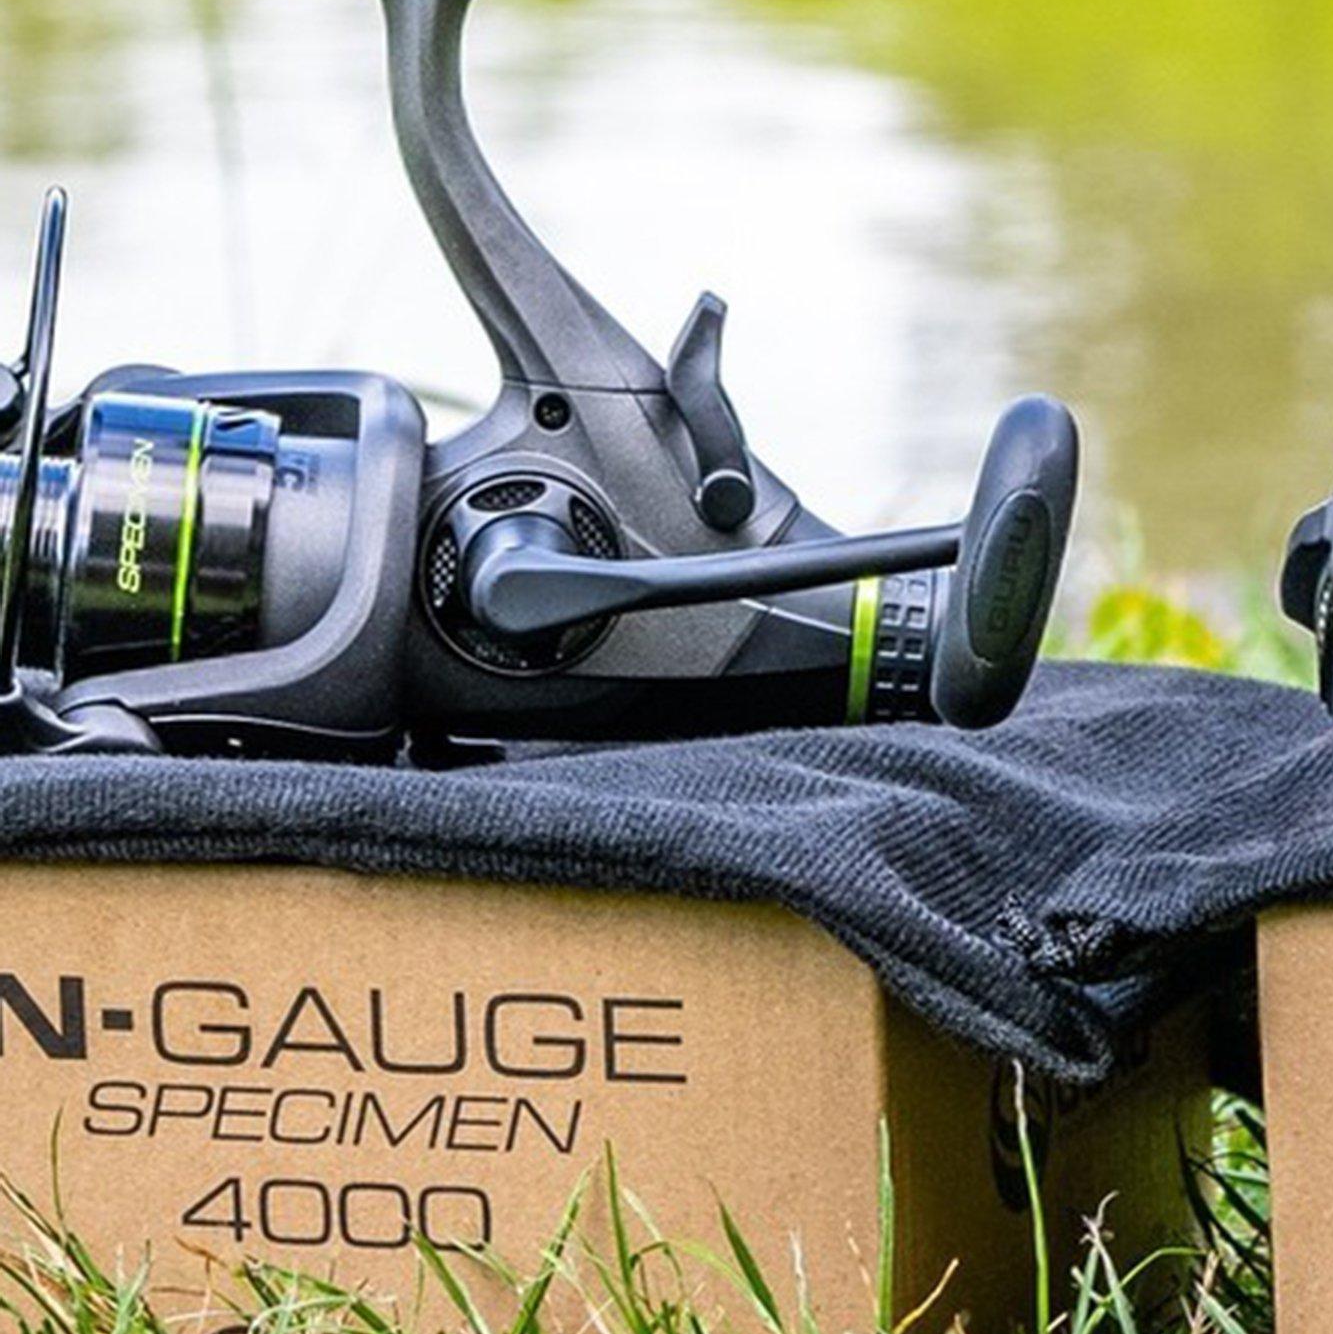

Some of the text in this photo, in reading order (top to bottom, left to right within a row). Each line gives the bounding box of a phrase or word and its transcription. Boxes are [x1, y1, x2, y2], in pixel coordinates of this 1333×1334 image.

[117, 438, 153, 593] SPECIMEN
[0, 974, 687, 1083] N-GAUGE
[83, 1081, 582, 1154] SPECIMEN
[182, 1177, 491, 1251] 4000
